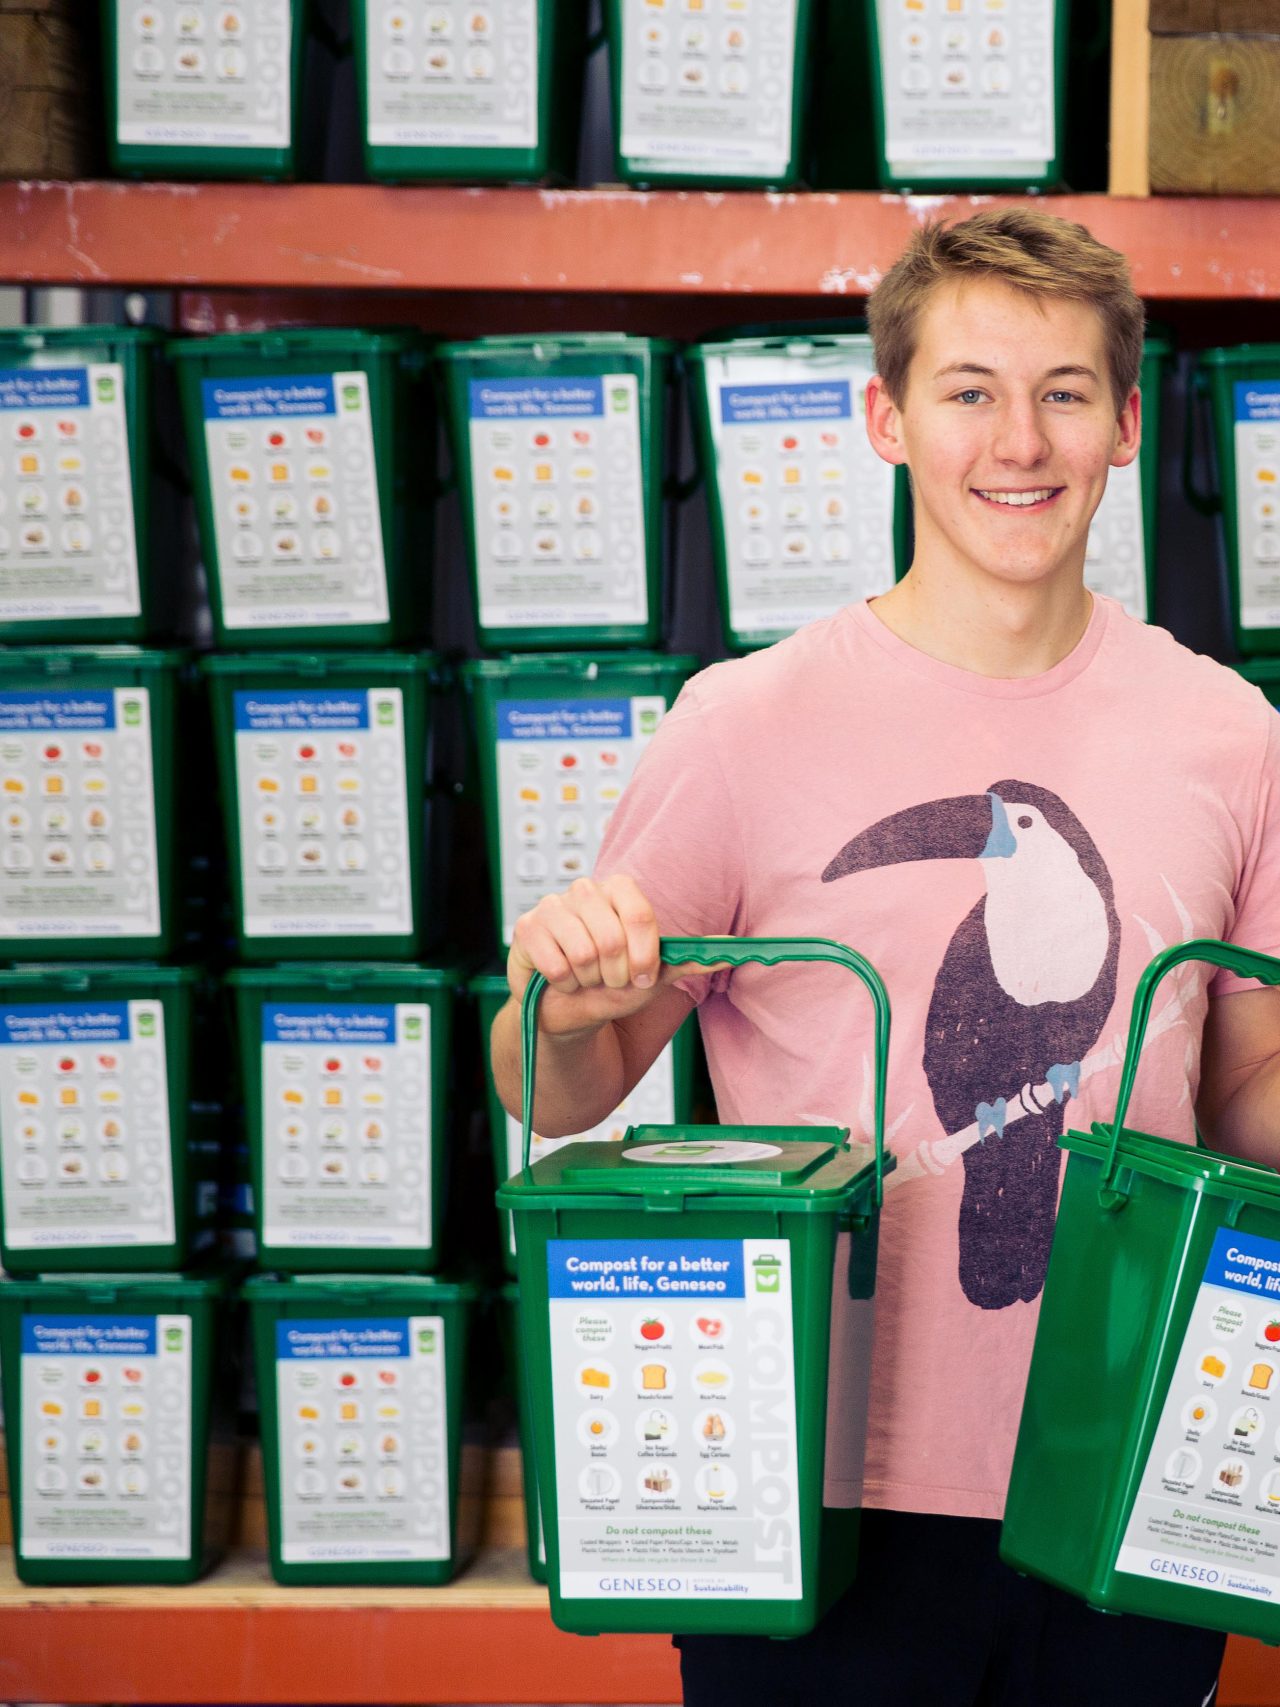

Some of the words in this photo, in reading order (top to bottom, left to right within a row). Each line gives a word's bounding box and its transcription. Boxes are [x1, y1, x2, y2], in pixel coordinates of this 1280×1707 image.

[566, 1256, 637, 1274] Compost
[640, 1256, 664, 1271] for
[668, 1260, 676, 1271] a
[680, 1256, 729, 1271] better
[571, 1276, 619, 1292] world,
[622, 1276, 653, 1292] life,
[656, 1276, 726, 1291] Geneseo
[1223, 1269, 1262, 1289] world,
[1217, 1305, 1242, 1318] Please
[578, 1316, 607, 1324] Please
[1212, 1314, 1243, 1327] compost
[1214, 1323, 1235, 1333] these
[746, 1307, 794, 1584] COMPOST
[1171, 1508, 1184, 1519] Do
[1185, 1513, 1201, 1522] not
[1201, 1517, 1237, 1530] compost
[1237, 1523, 1260, 1535] these
[605, 1526, 618, 1534] Do
[621, 1526, 638, 1534] not
[641, 1527, 683, 1536] compost
[685, 1526, 712, 1535] these
[1149, 1557, 1219, 1583] GENESEO
[598, 1578, 681, 1591] GENESEO
[693, 1583, 748, 1592] Sustainability
[1226, 1578, 1272, 1595] Sustainability
